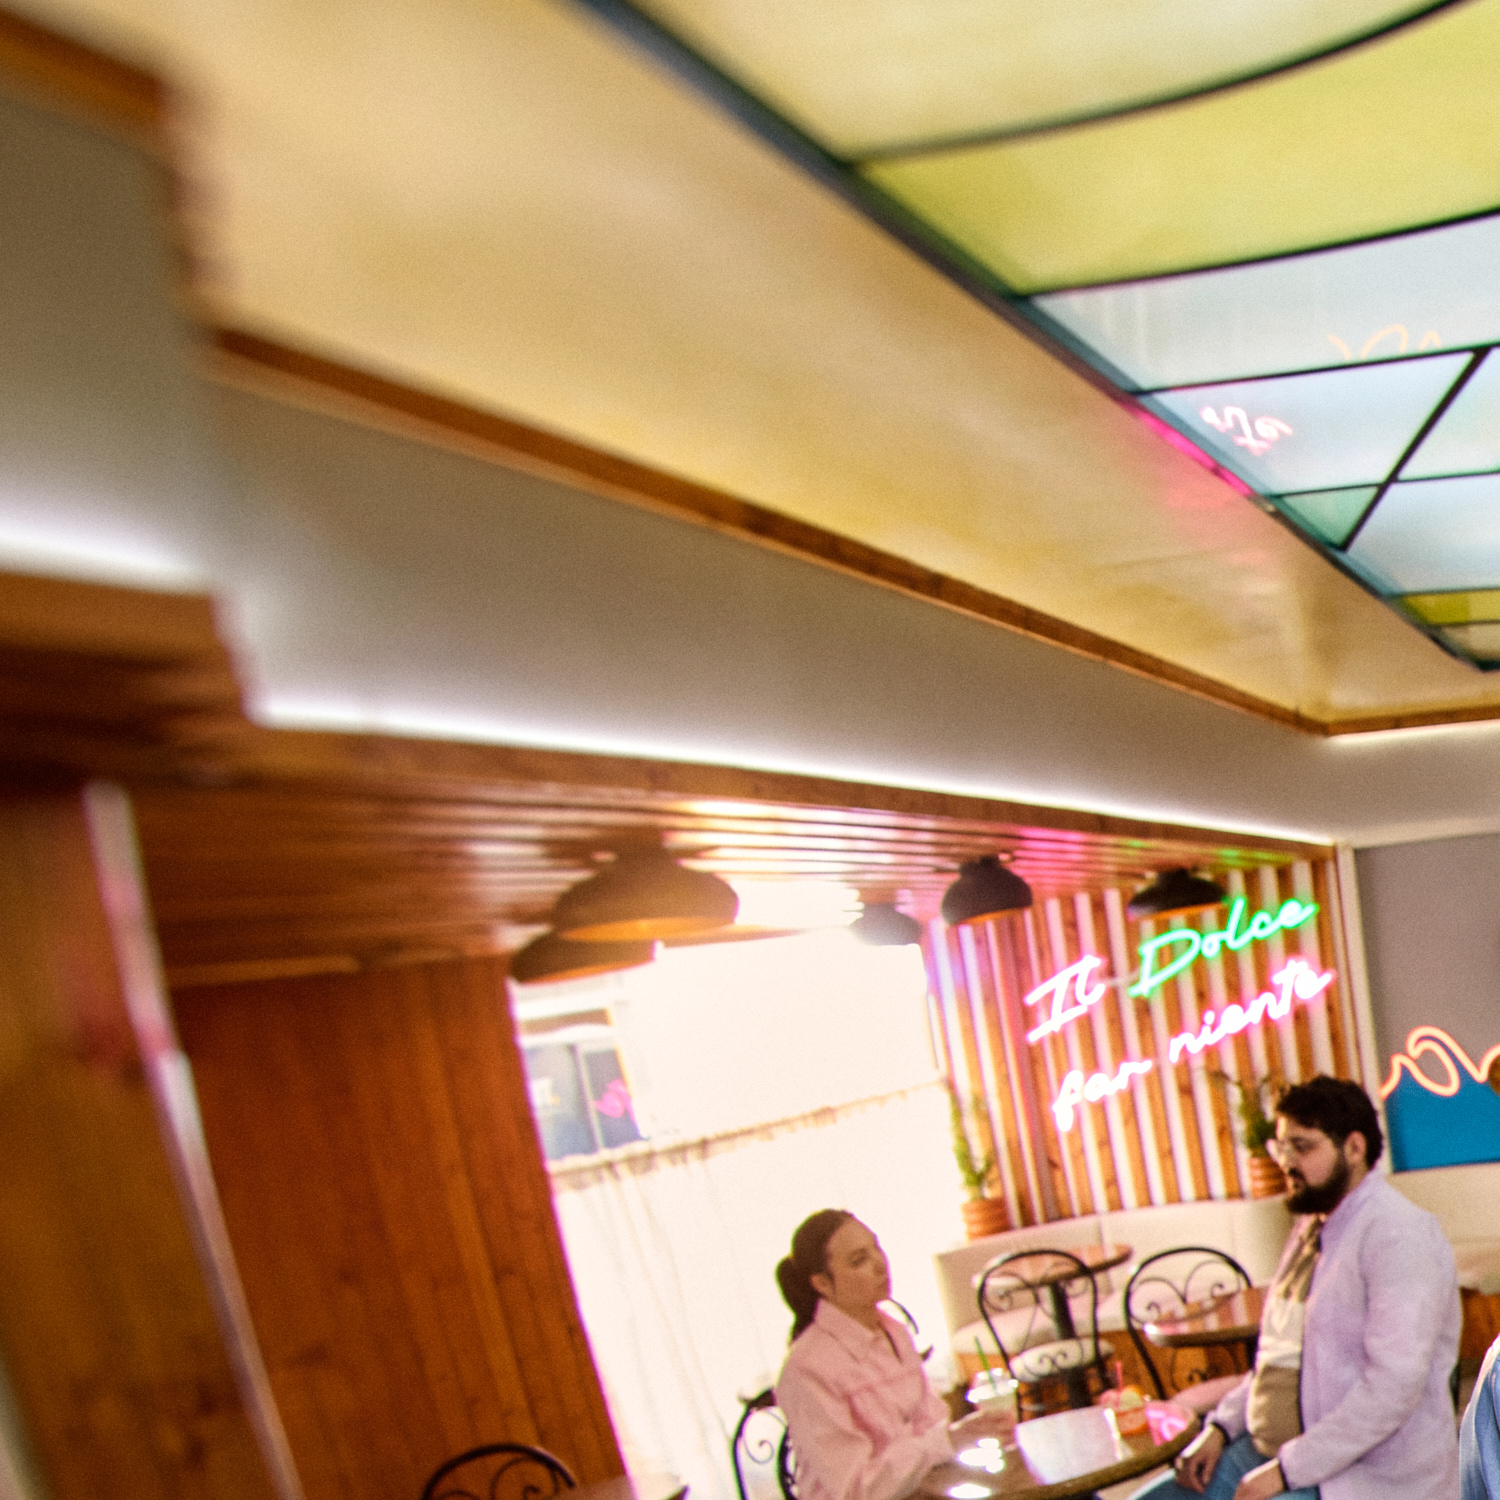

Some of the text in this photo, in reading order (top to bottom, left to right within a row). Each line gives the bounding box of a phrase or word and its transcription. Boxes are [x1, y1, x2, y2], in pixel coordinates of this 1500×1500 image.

[1127, 896, 1318, 998] Dolce
[1051, 957, 1337, 1132] far niente
